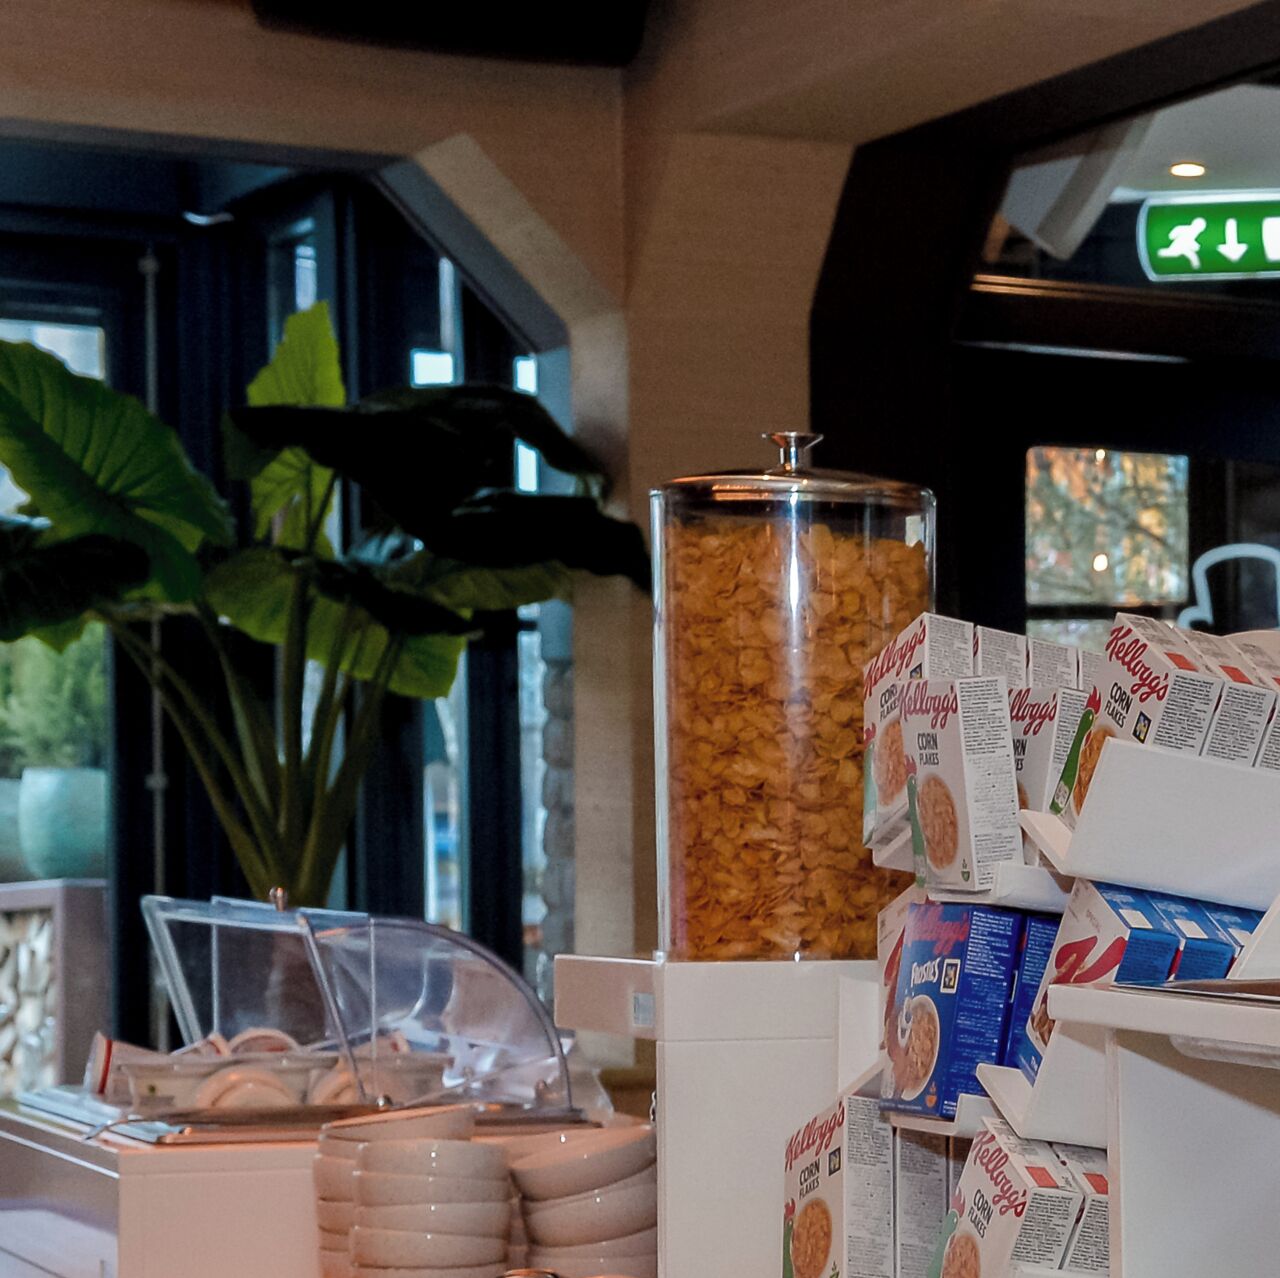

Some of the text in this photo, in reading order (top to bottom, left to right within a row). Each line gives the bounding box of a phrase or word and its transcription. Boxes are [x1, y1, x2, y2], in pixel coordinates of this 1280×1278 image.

[864, 620, 926, 698] Kellogg's
[1105, 625, 1169, 703] Kellogg's
[897, 680, 958, 730] Kellogg's
[1104, 700, 1127, 728] FLAKES
[1110, 682, 1134, 715] CORN
[917, 732, 938, 751] CORN
[919, 752, 940, 765] FLAKES
[784, 1101, 845, 1173] Kellogg's
[799, 1157, 821, 1186] CORN
[799, 1175, 820, 1200] FLAKES
[972, 1130, 1028, 1218] Kellogg's
[967, 1206, 987, 1239] FLAKES
[973, 1188, 994, 1225] CORN
